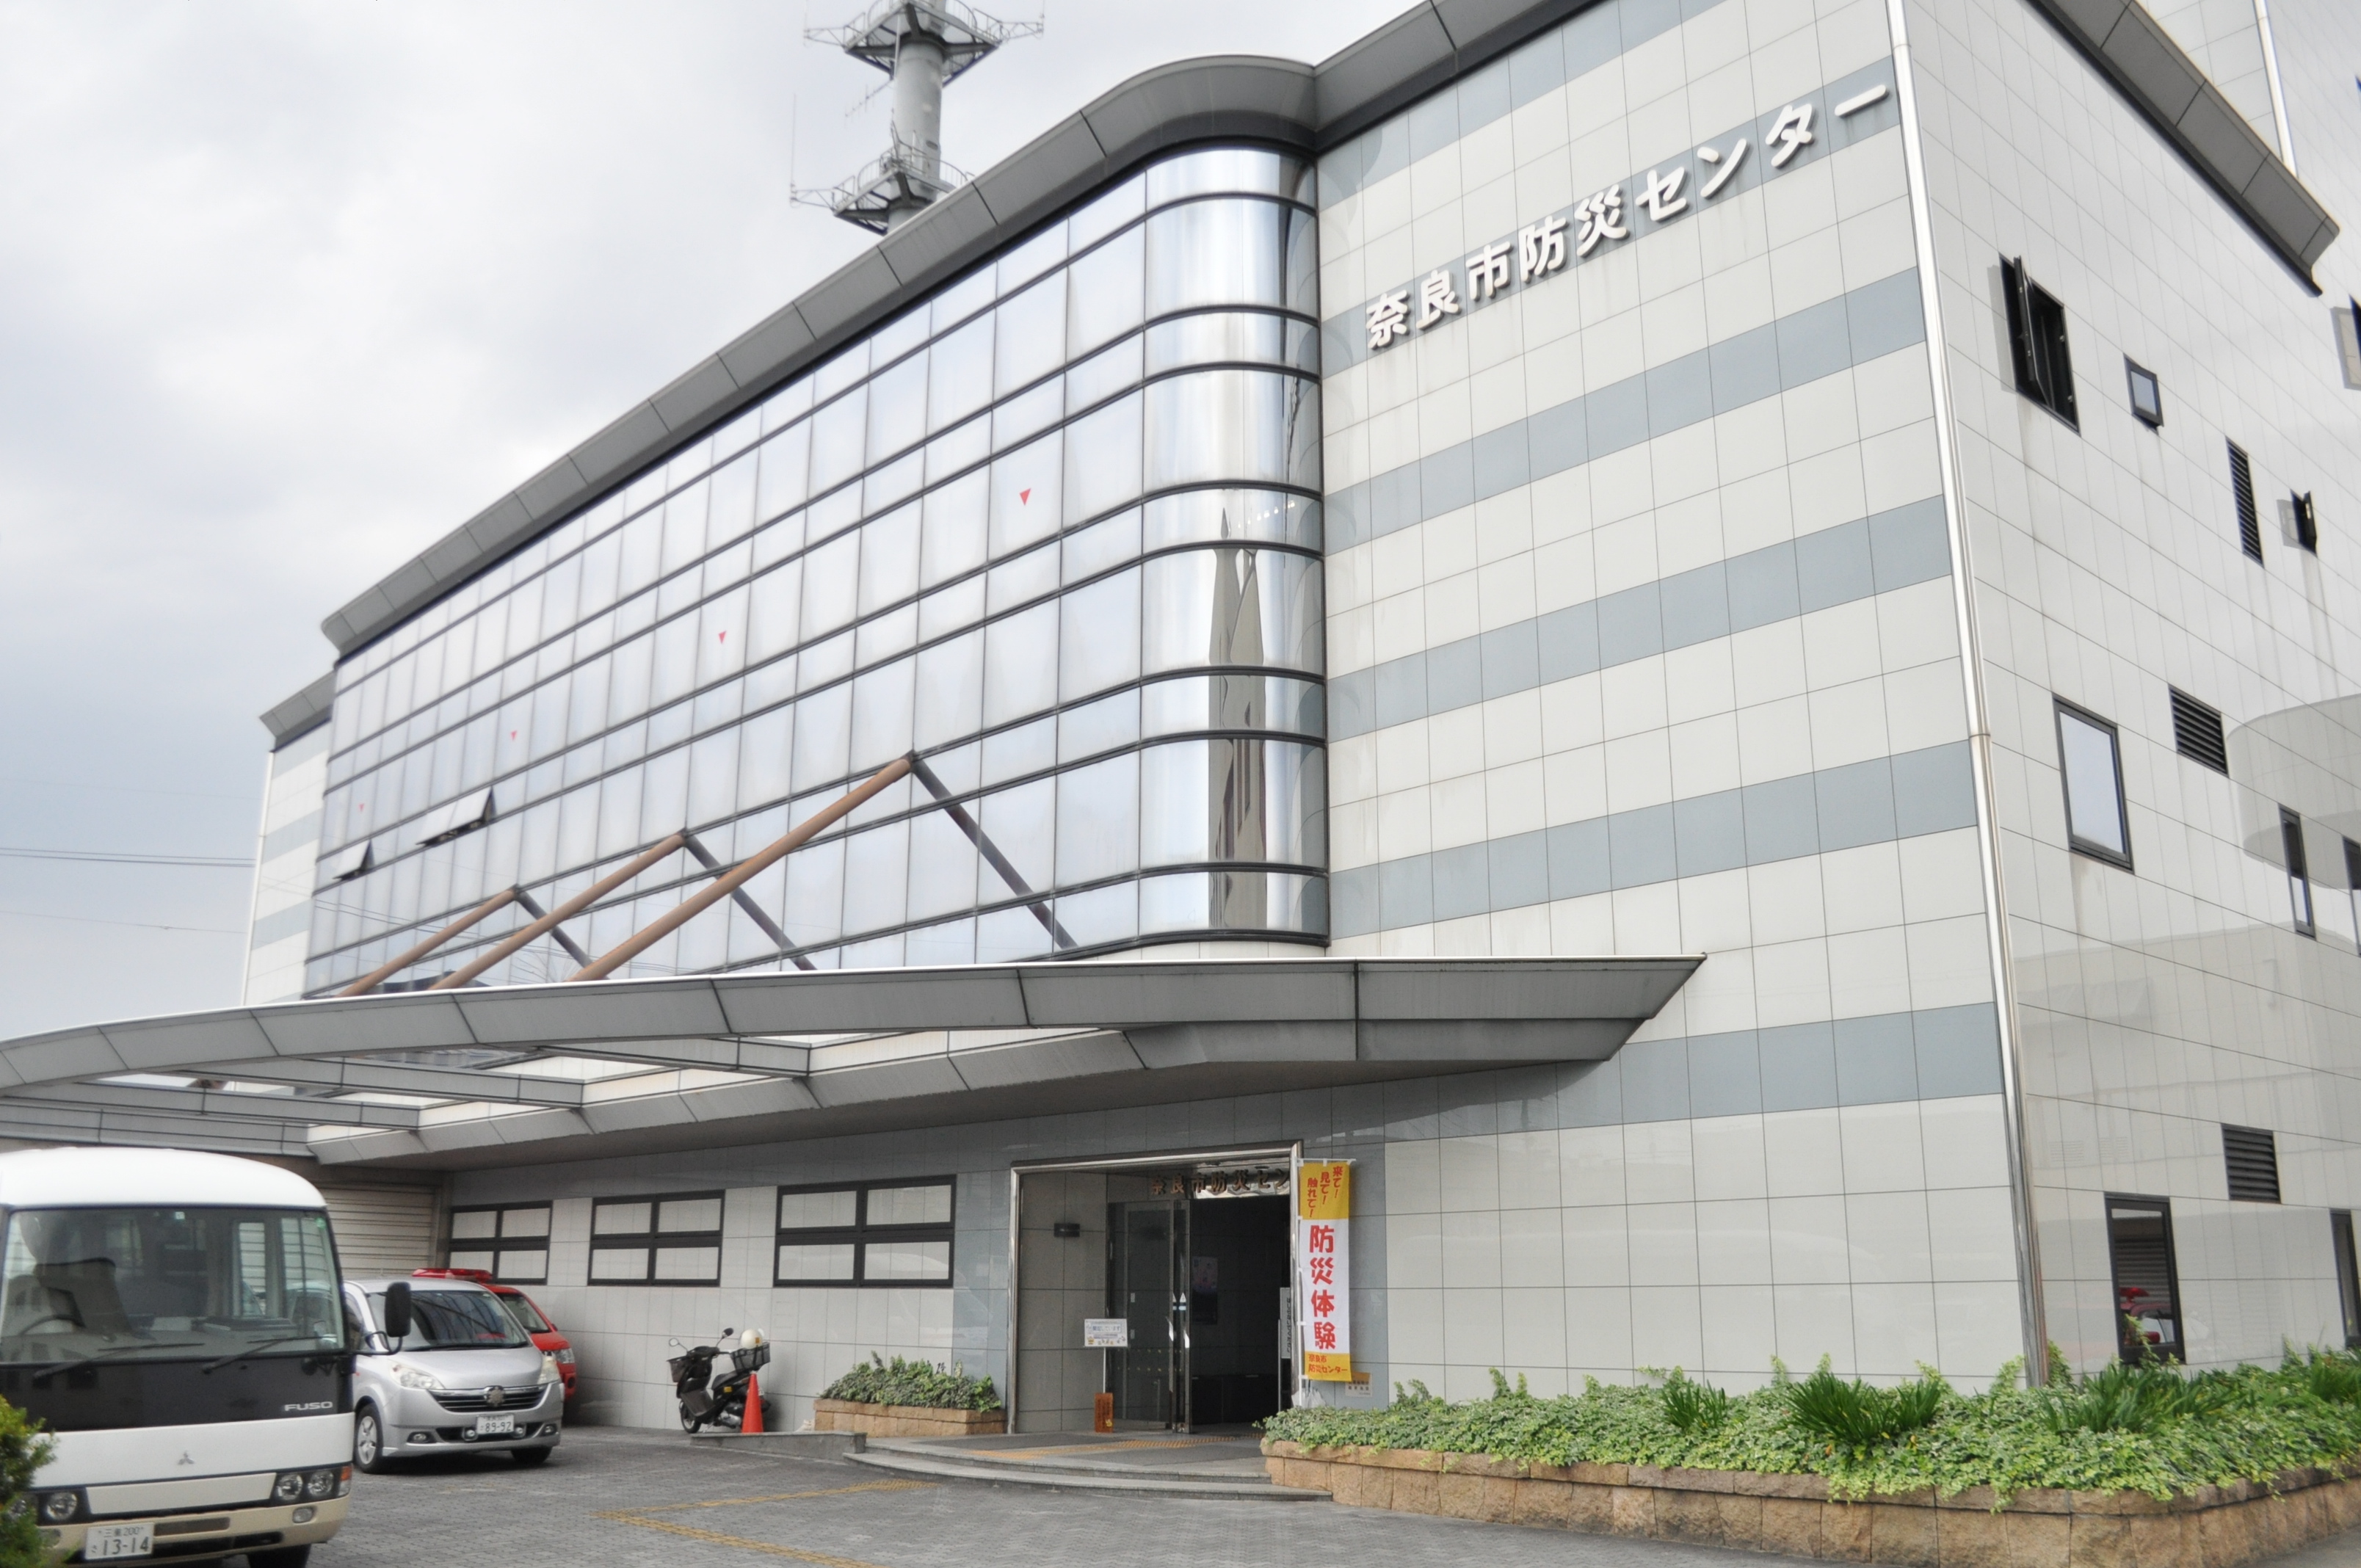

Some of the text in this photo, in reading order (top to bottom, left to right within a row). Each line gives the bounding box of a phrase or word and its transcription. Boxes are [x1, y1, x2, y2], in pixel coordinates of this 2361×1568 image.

[1366, 84, 1892, 351] 奈良市防災センター
[1310, 1224, 1335, 1350] 防災体験
[1308, 1354, 1327, 1362] 奈良市
[1308, 1364, 1348, 1373] 防災センター
[284, 1401, 333, 1412] FUSO
[485, 1421, 511, 1432] 89-92
[104, 1536, 149, 1556] 13-14
